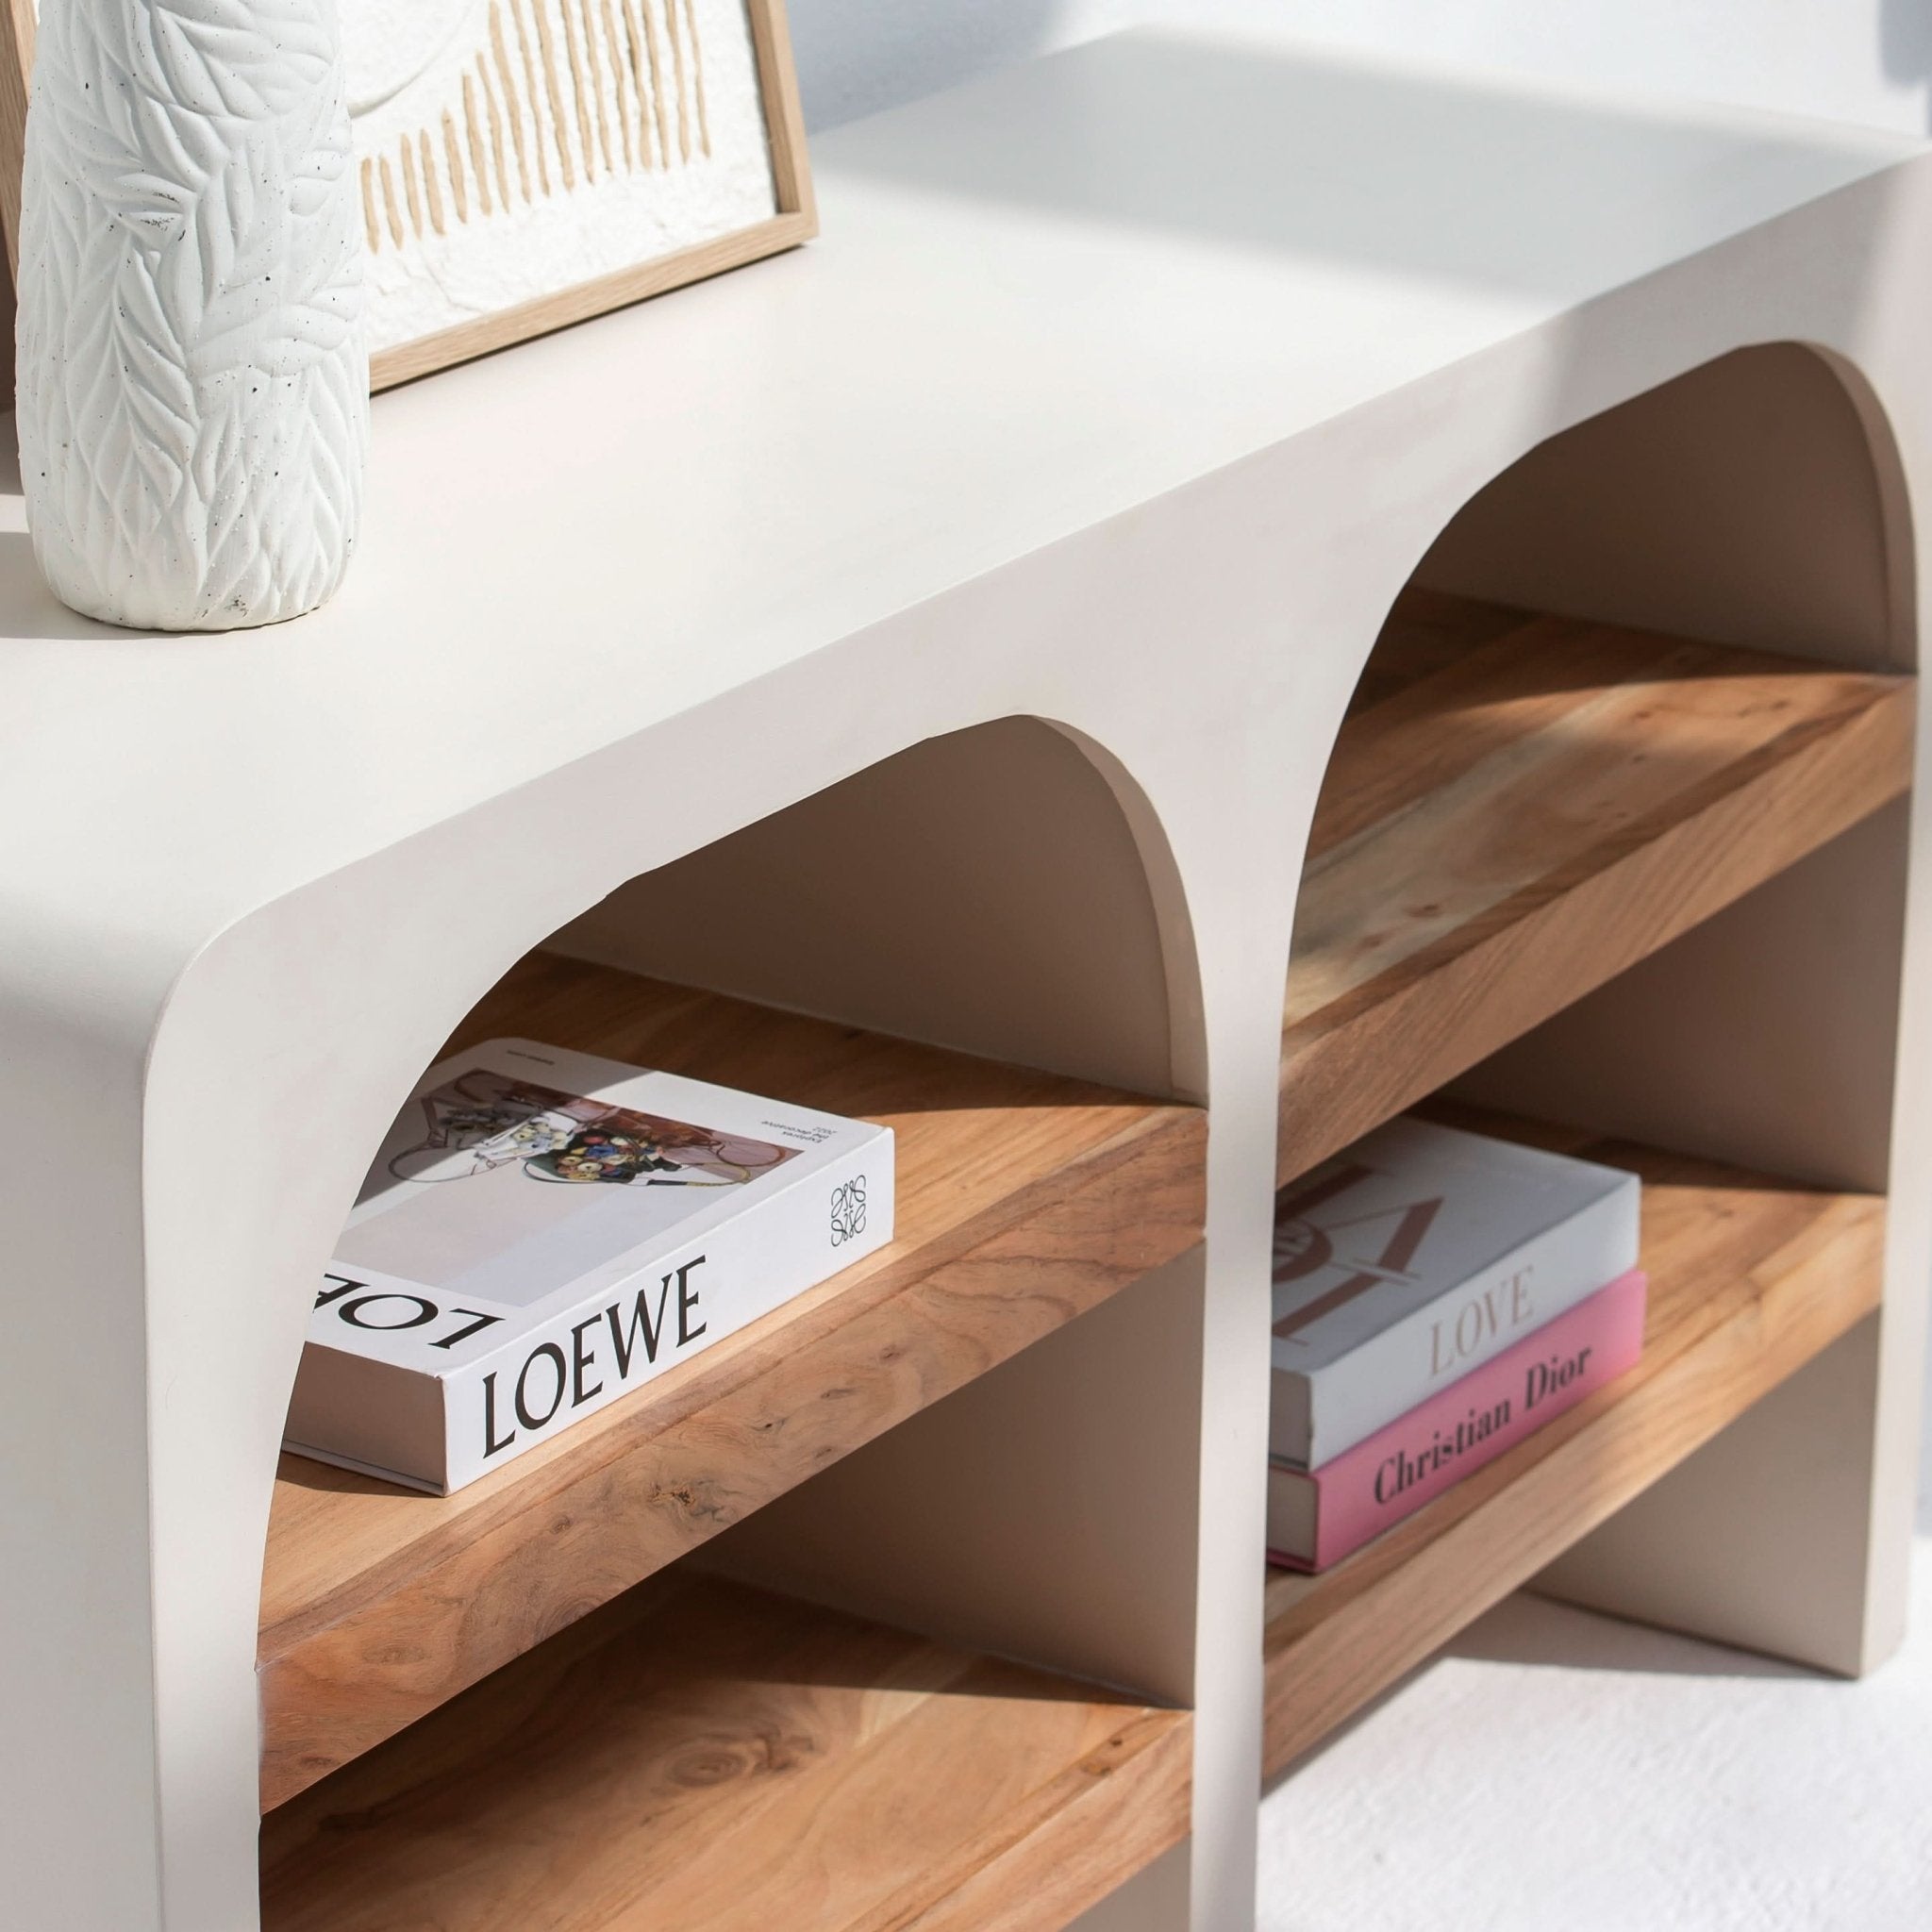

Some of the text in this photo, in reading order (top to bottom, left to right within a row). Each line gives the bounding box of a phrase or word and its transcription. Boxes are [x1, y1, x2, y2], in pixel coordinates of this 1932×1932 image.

[482, 1254, 707, 1459] LOEWE
[1429, 1264, 1535, 1378] LOVE
[1374, 1346, 1592, 1506] Christian Dior
